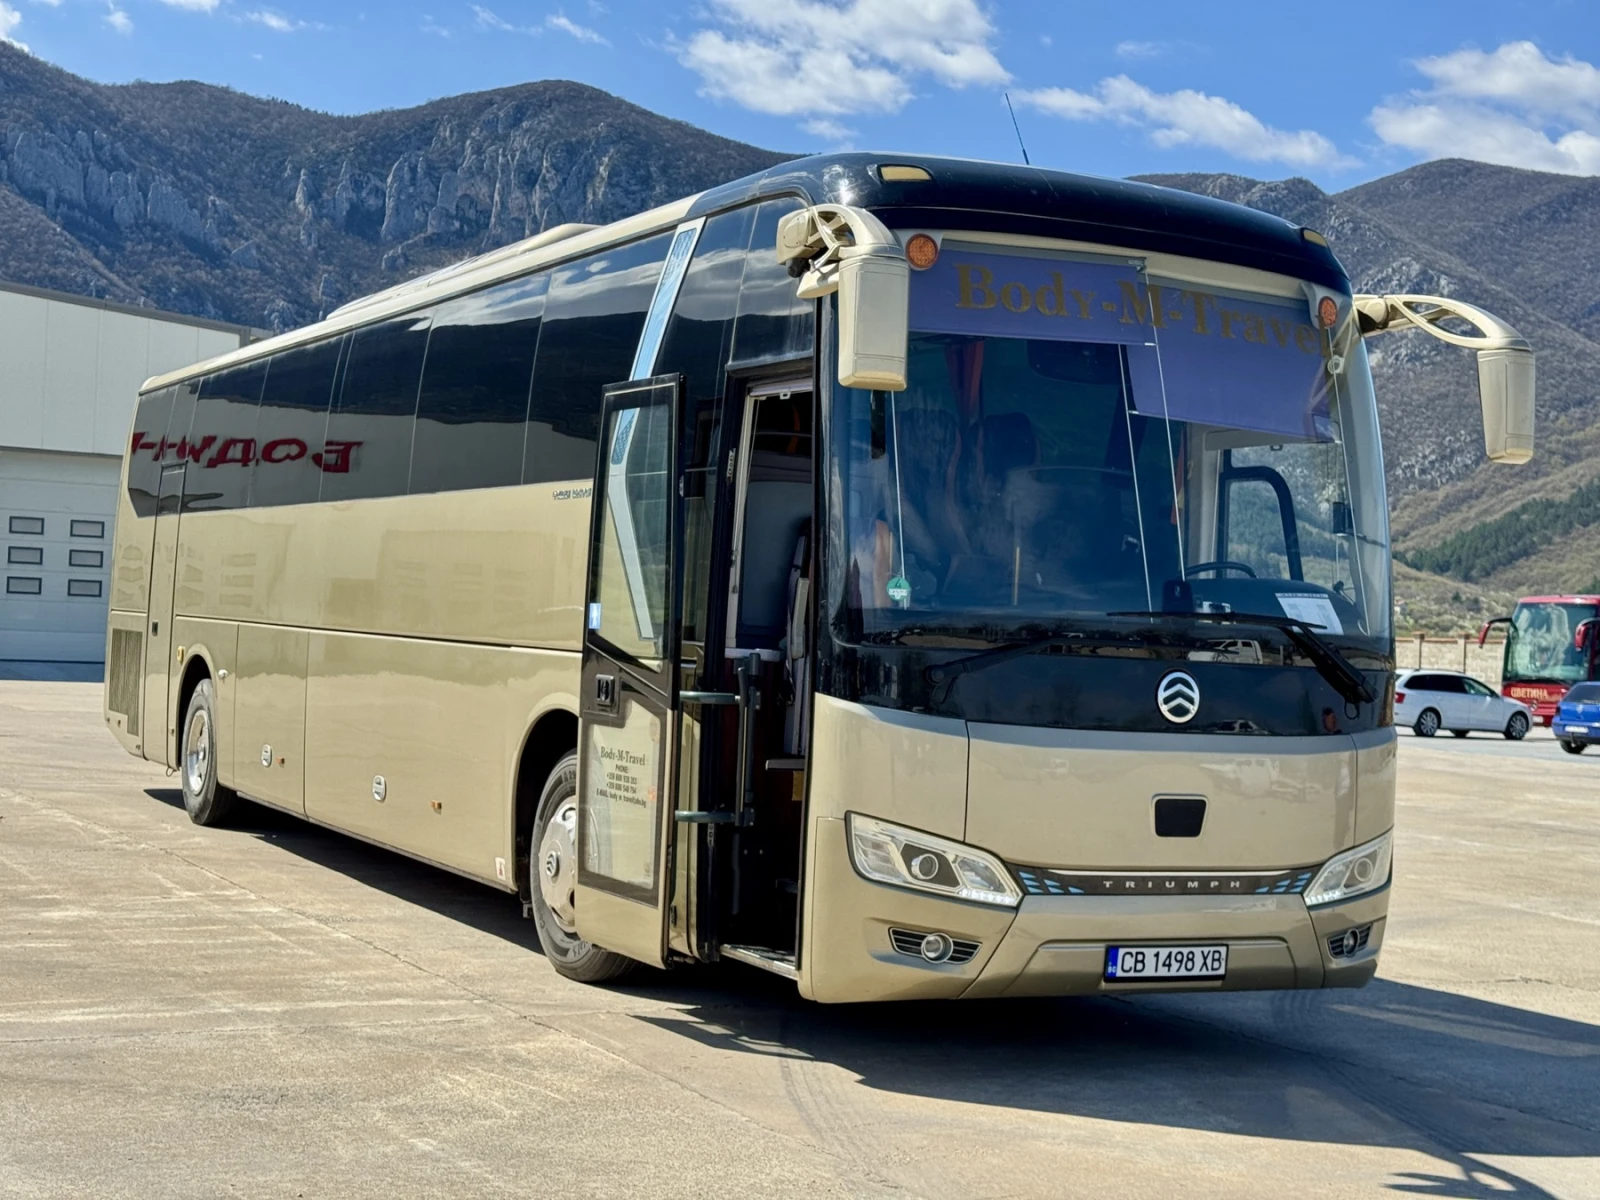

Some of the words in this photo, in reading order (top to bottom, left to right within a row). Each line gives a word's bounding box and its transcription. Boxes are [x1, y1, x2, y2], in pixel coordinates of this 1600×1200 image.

[1121, 951, 1146, 973] CB
[1153, 950, 1195, 973] 1498
[1199, 949, 1222, 972] XB
